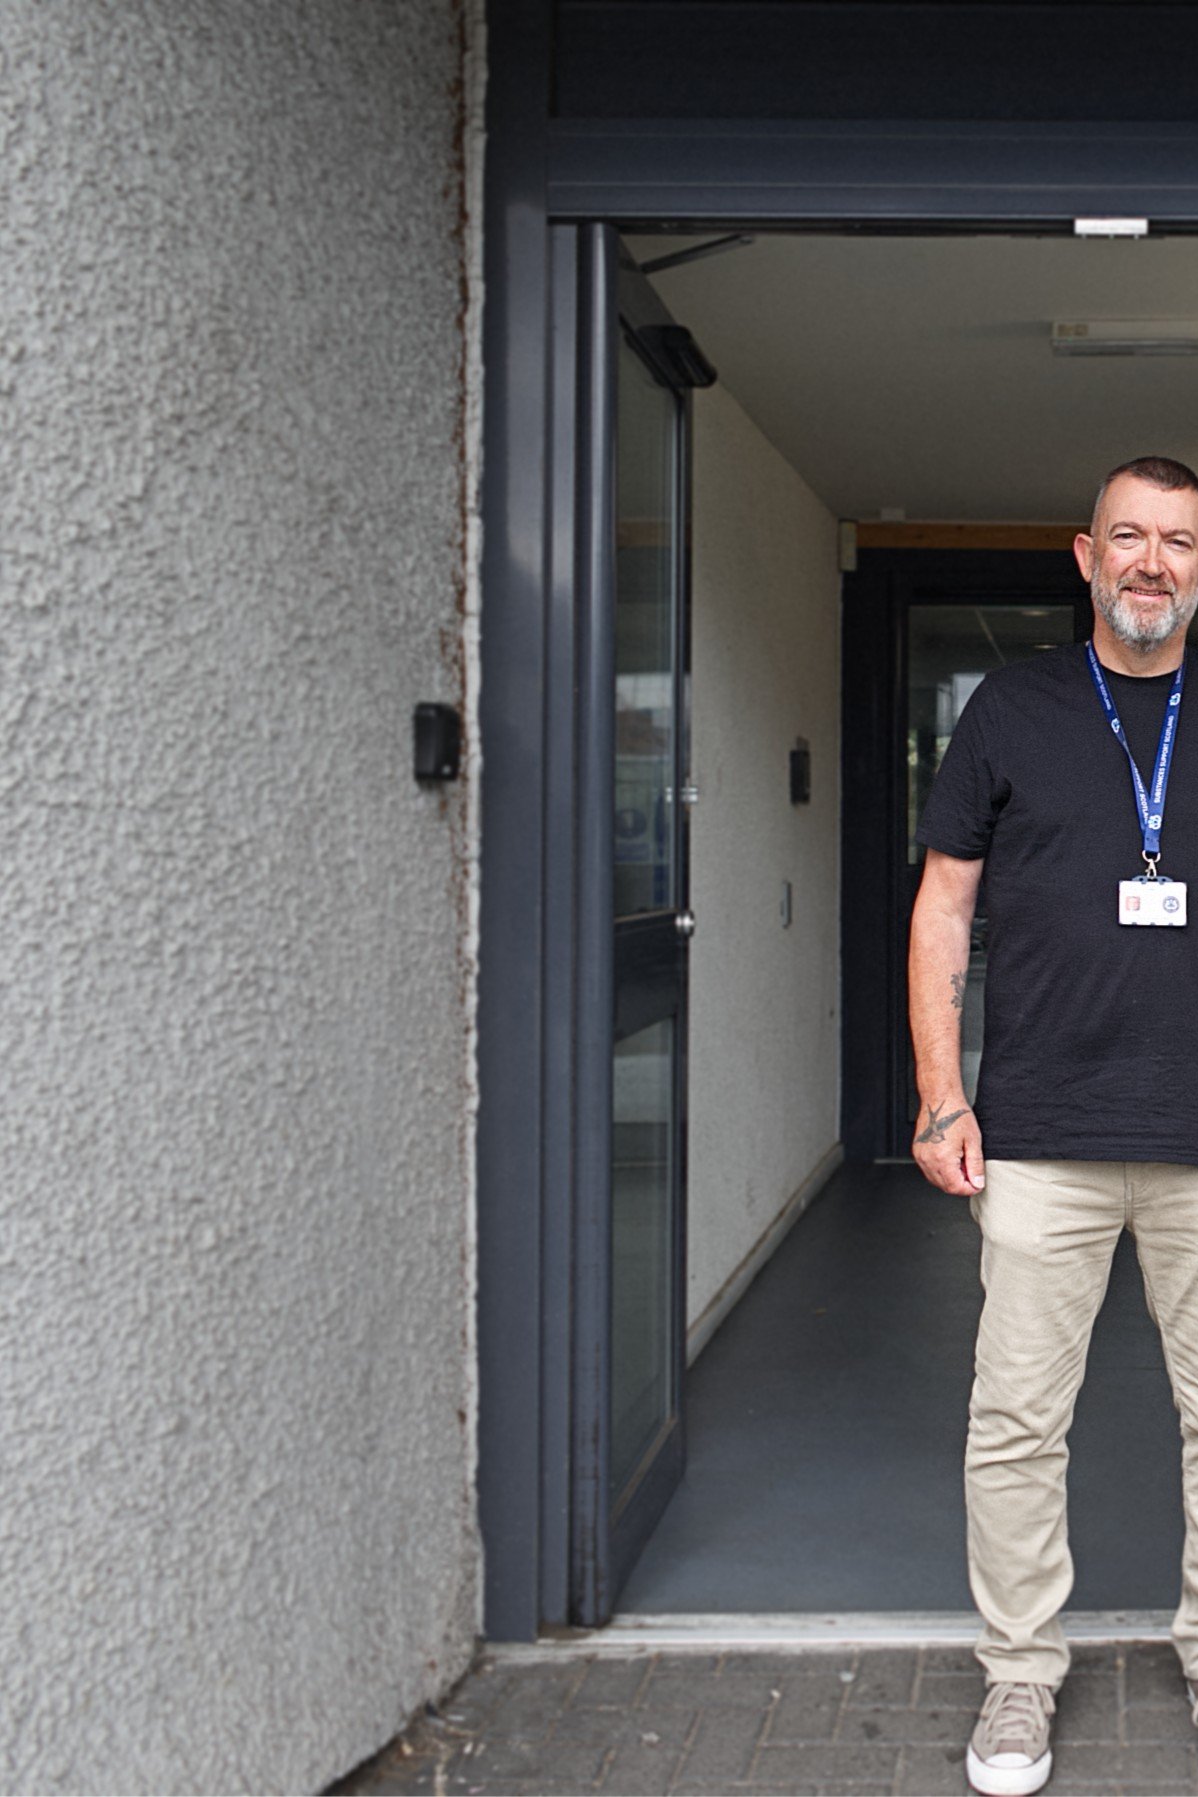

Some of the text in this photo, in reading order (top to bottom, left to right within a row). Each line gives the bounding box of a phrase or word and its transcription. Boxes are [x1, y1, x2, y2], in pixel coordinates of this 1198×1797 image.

[1154, 715, 1174, 803] SUBSTANCES SUPPORT SCOTLAND
